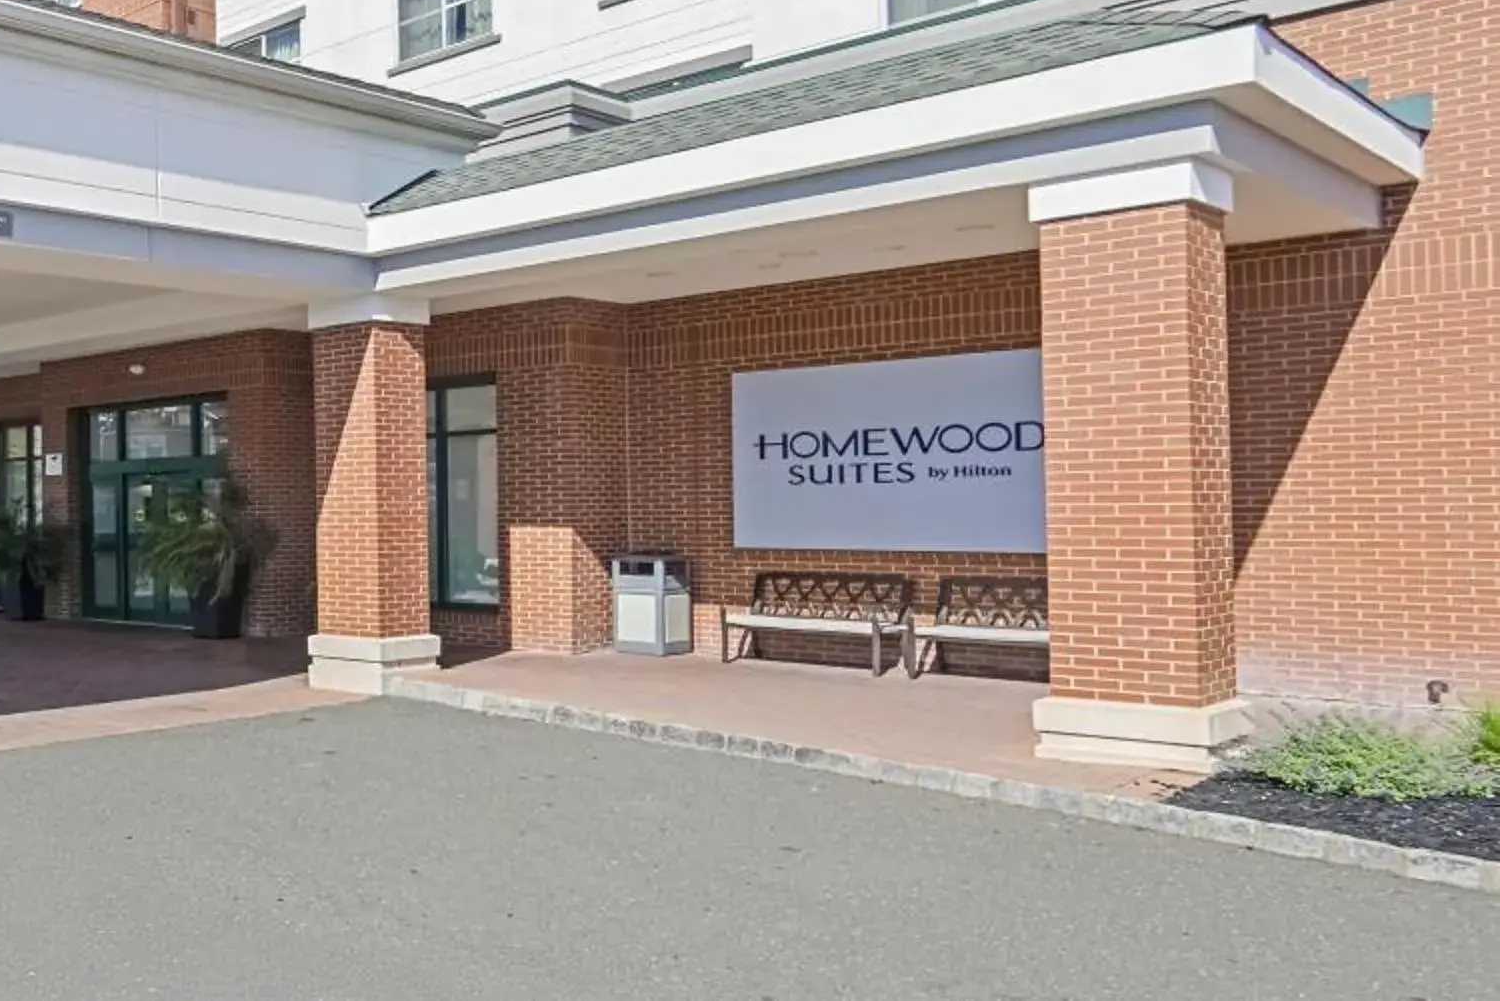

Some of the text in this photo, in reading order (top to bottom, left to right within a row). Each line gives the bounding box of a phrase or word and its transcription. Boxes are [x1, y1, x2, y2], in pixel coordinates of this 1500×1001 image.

[753, 420, 1045, 460] HOMEWOOD
[788, 462, 1012, 485] SUITES by Hilton
